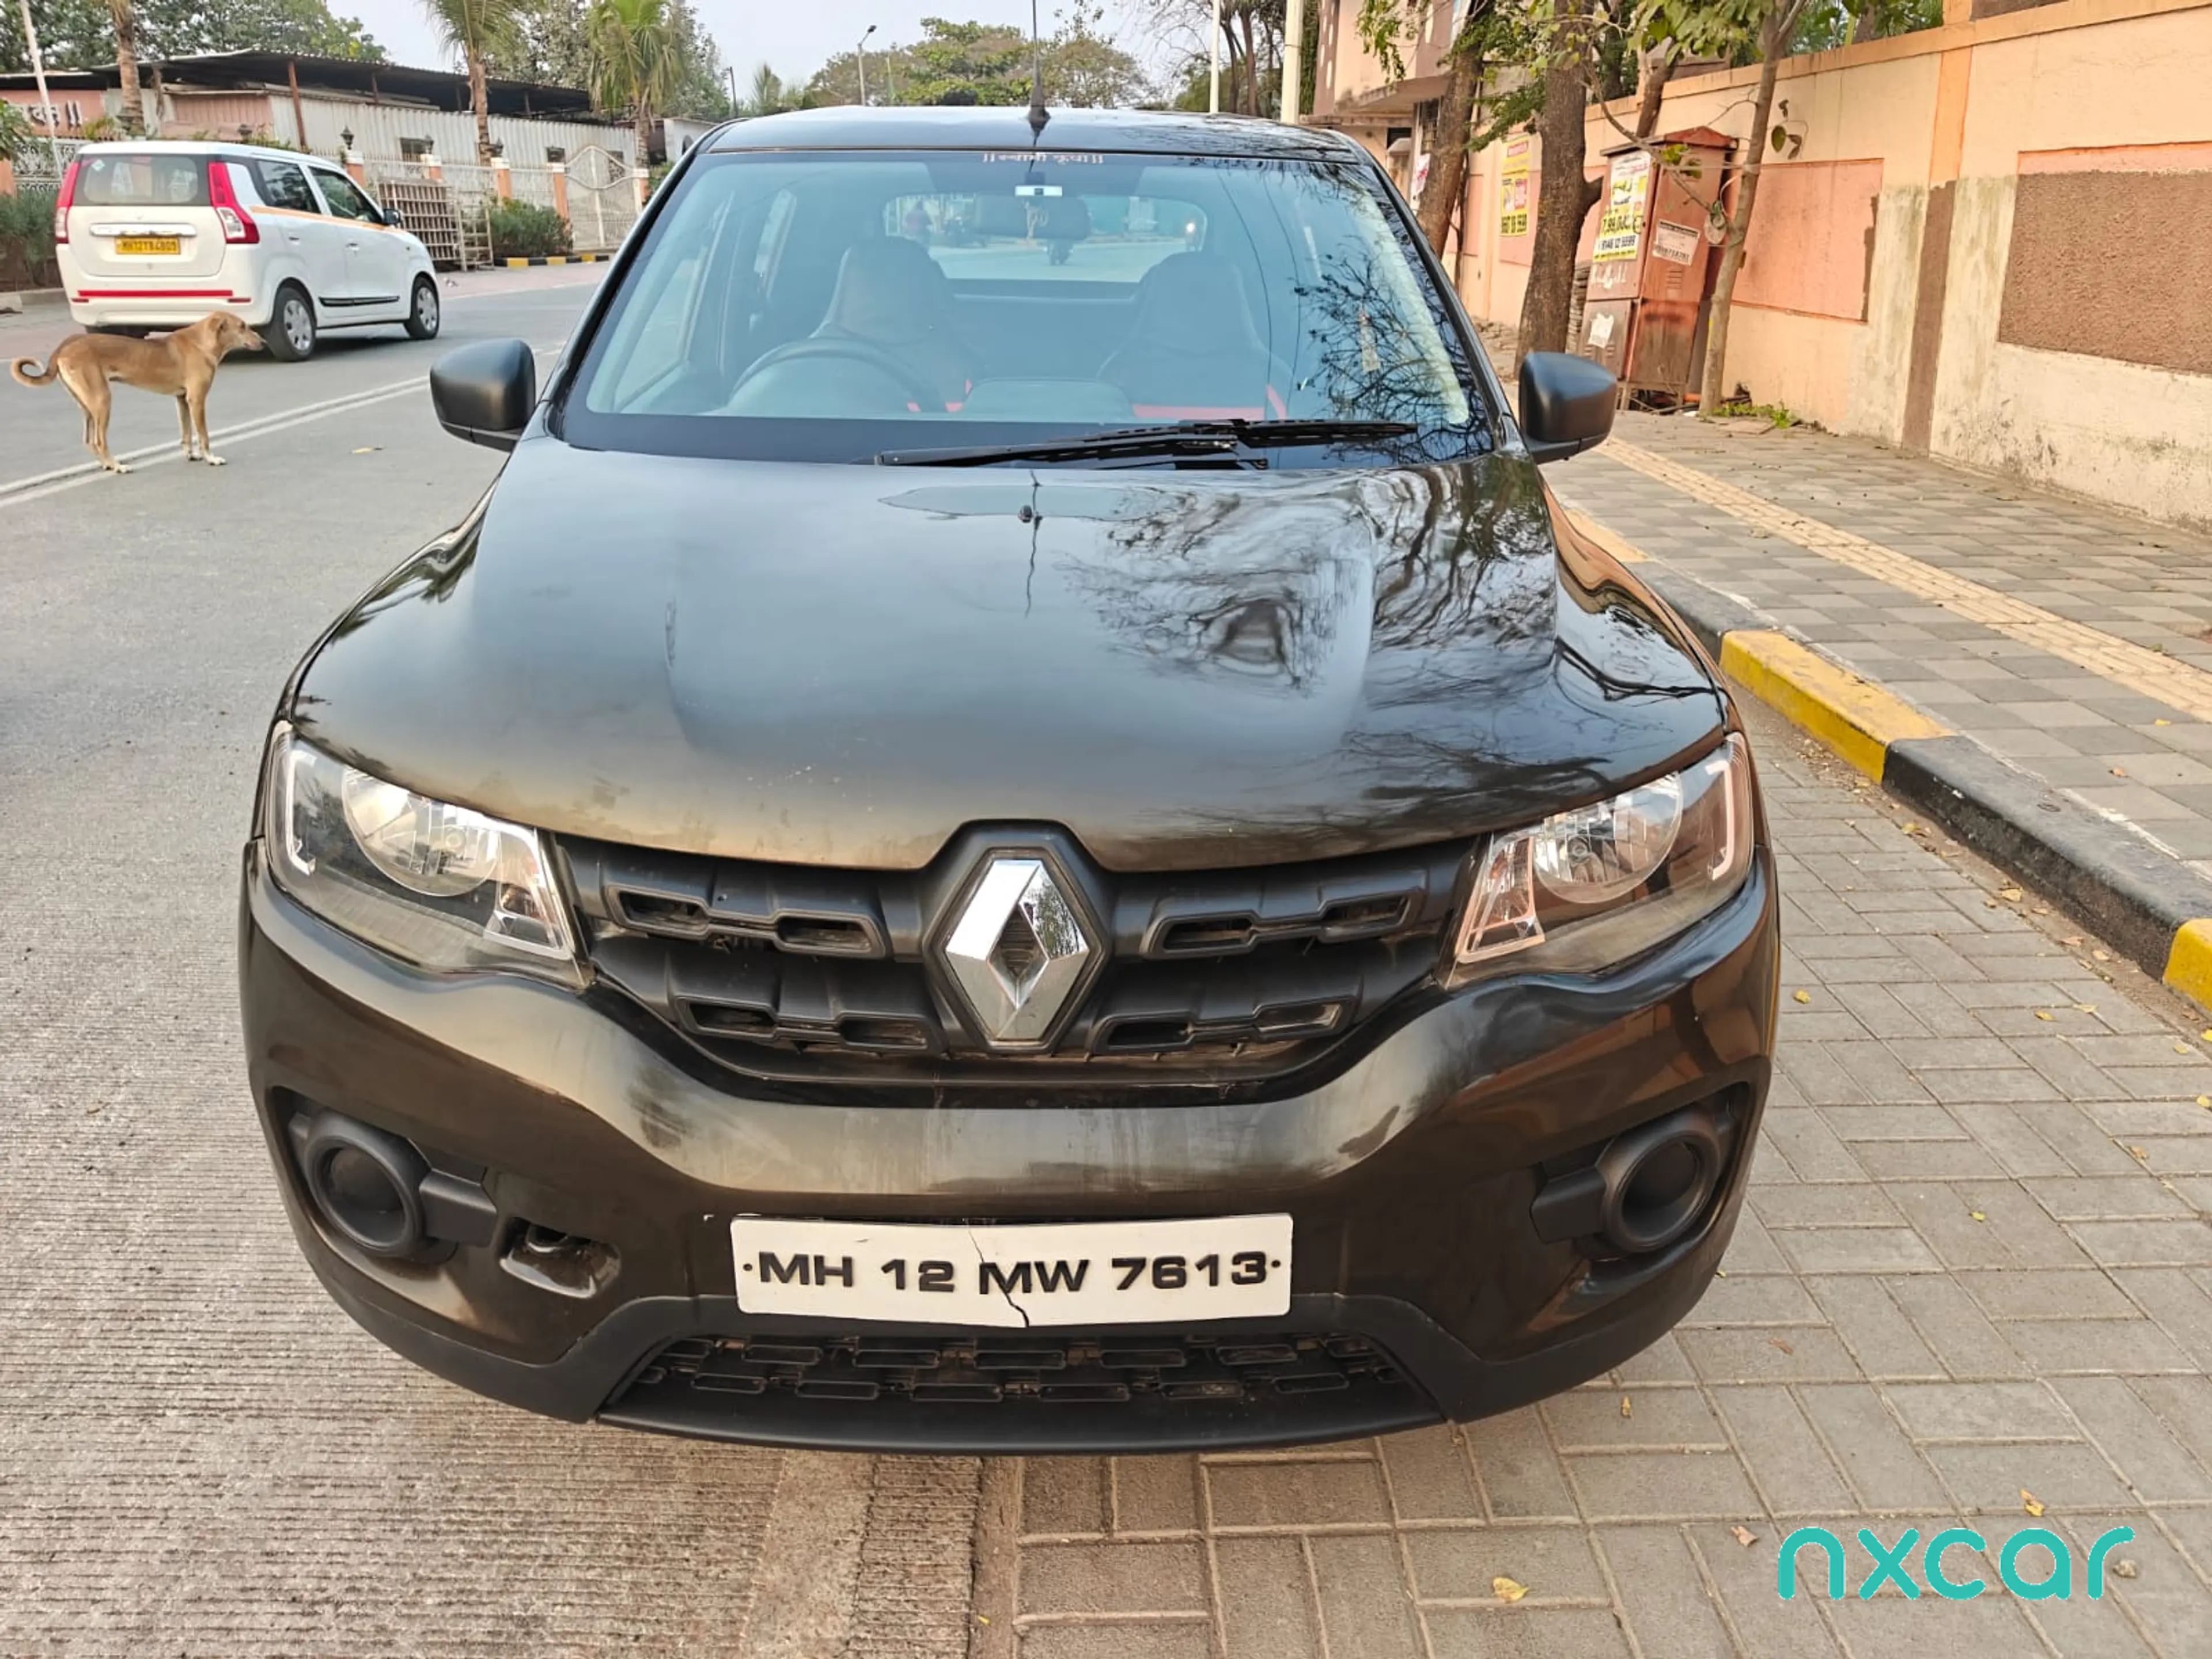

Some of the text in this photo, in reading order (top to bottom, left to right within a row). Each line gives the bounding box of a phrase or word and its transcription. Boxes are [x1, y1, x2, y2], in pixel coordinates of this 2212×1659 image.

[759, 1251, 1267, 1295] MH 12 MW 7613
